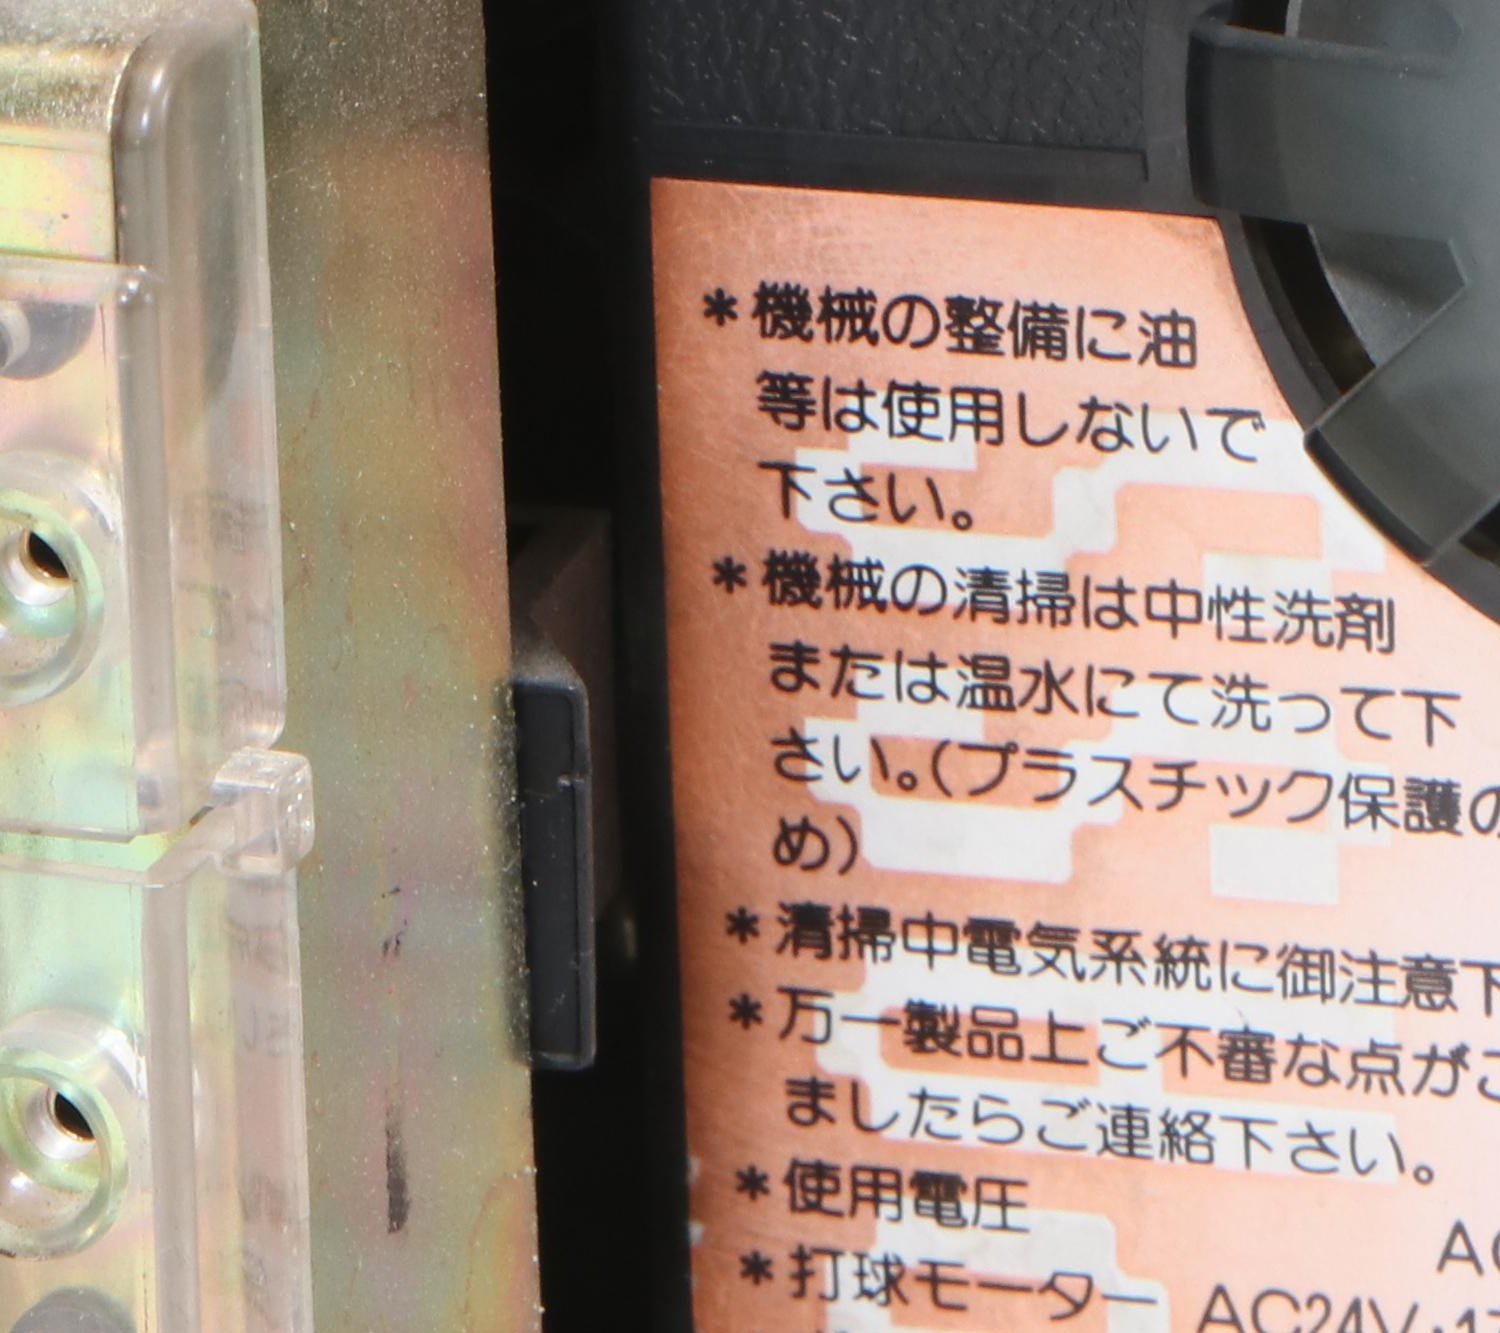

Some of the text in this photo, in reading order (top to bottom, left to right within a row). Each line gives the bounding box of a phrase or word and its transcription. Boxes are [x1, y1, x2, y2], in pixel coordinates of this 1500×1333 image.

[752, 279, 1200, 371] 機械の整備に油
[757, 368, 1268, 464] 等は使用しないで
[759, 463, 976, 533] 下さい。
[762, 548, 1398, 654] 機械の清掃は中性洗剤
[769, 640, 1461, 748] または温水にて洗って下
[785, 1076, 1435, 1187] ましたらご連絡下さい。
[784, 1160, 1031, 1236] 使用電圧
[789, 1243, 1158, 1317] 打球モーター
